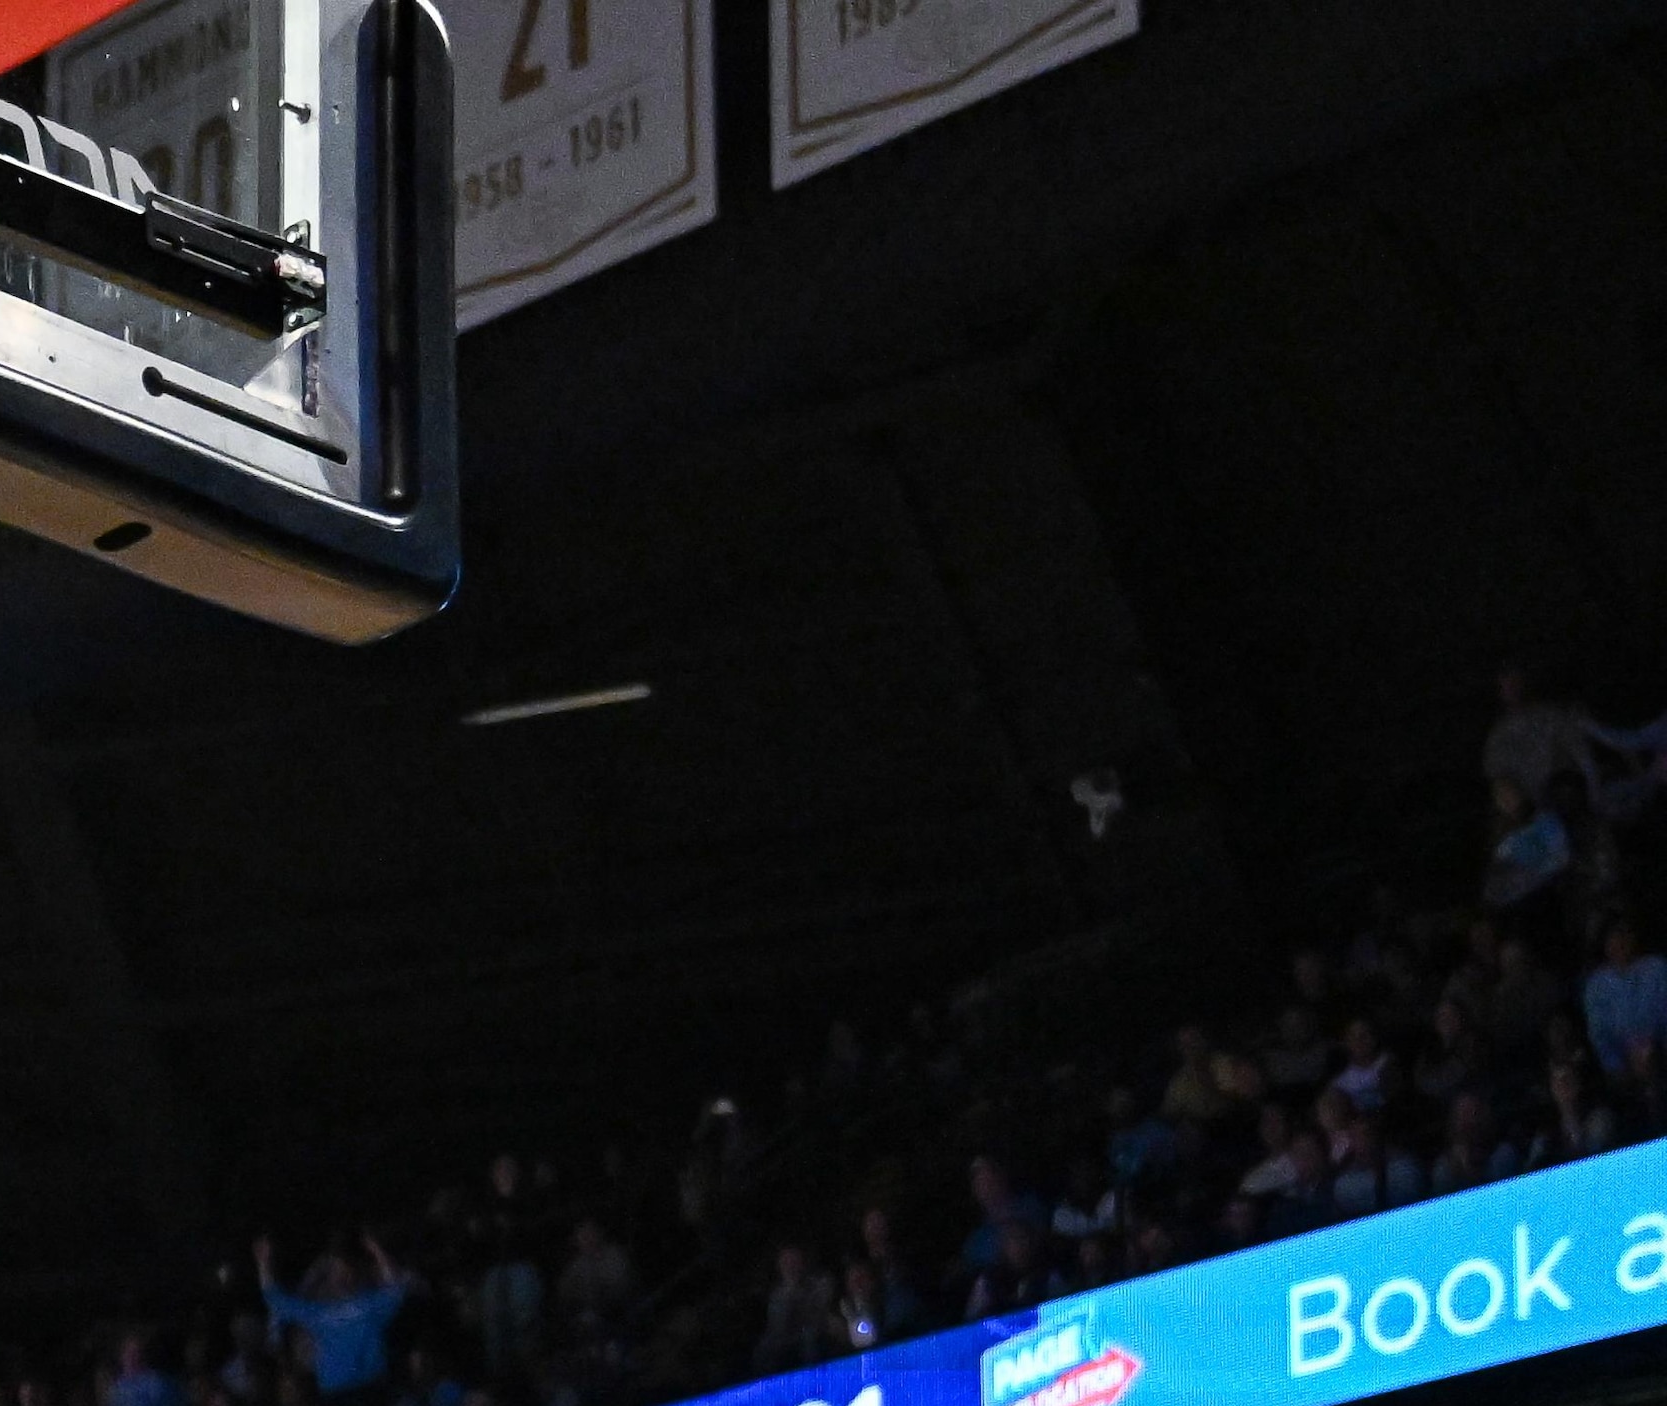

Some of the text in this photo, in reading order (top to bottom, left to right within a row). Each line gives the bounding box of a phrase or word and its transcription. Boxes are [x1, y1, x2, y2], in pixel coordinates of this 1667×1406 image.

[568, 95, 643, 169] 1961
[1287, 1222, 1571, 1378] Book
[993, 1325, 1082, 1401] PAGE
